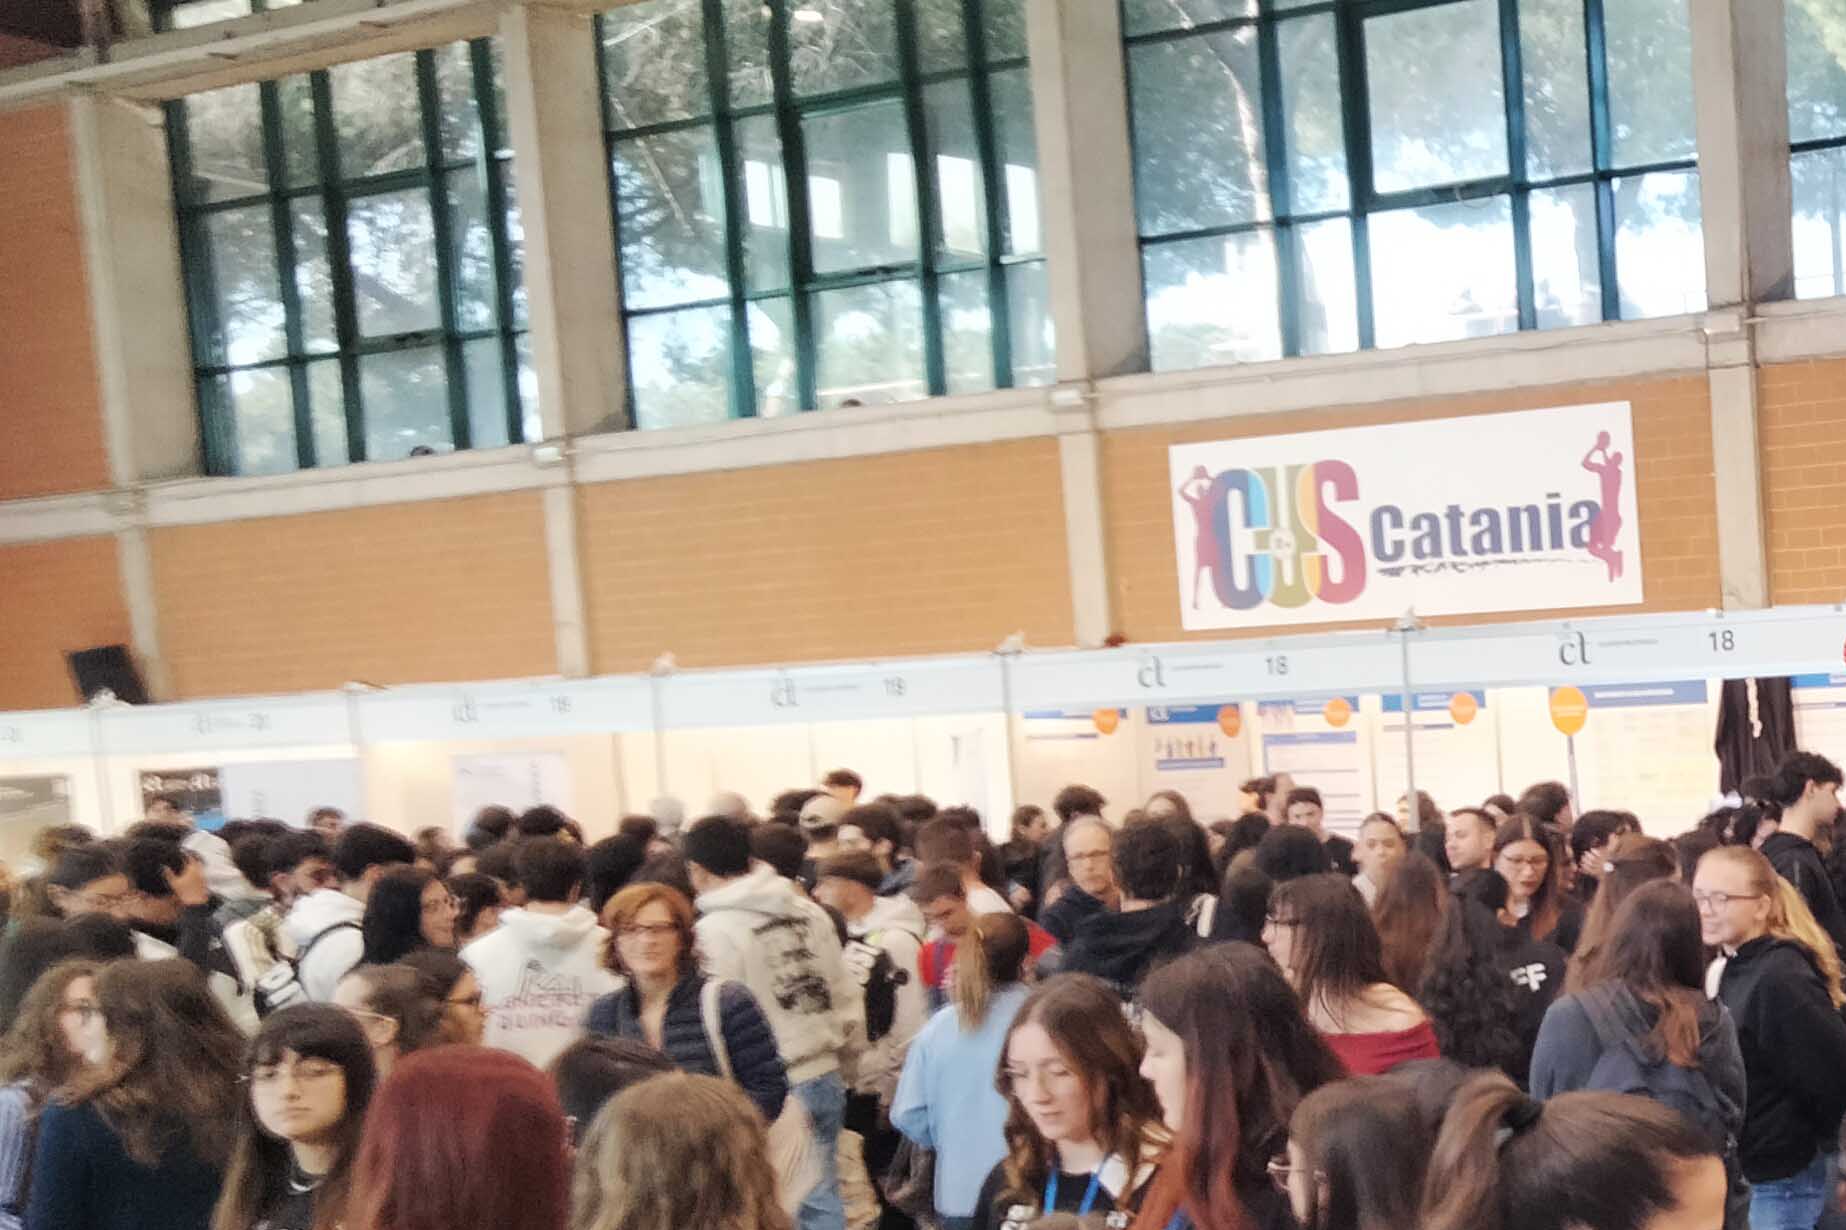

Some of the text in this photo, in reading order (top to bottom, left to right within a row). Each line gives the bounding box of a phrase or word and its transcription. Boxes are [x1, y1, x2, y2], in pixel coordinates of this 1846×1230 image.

[1210, 458, 1605, 611] CUS Catania
[1708, 629, 1735, 652] 18
[1265, 655, 1289, 676] 18
